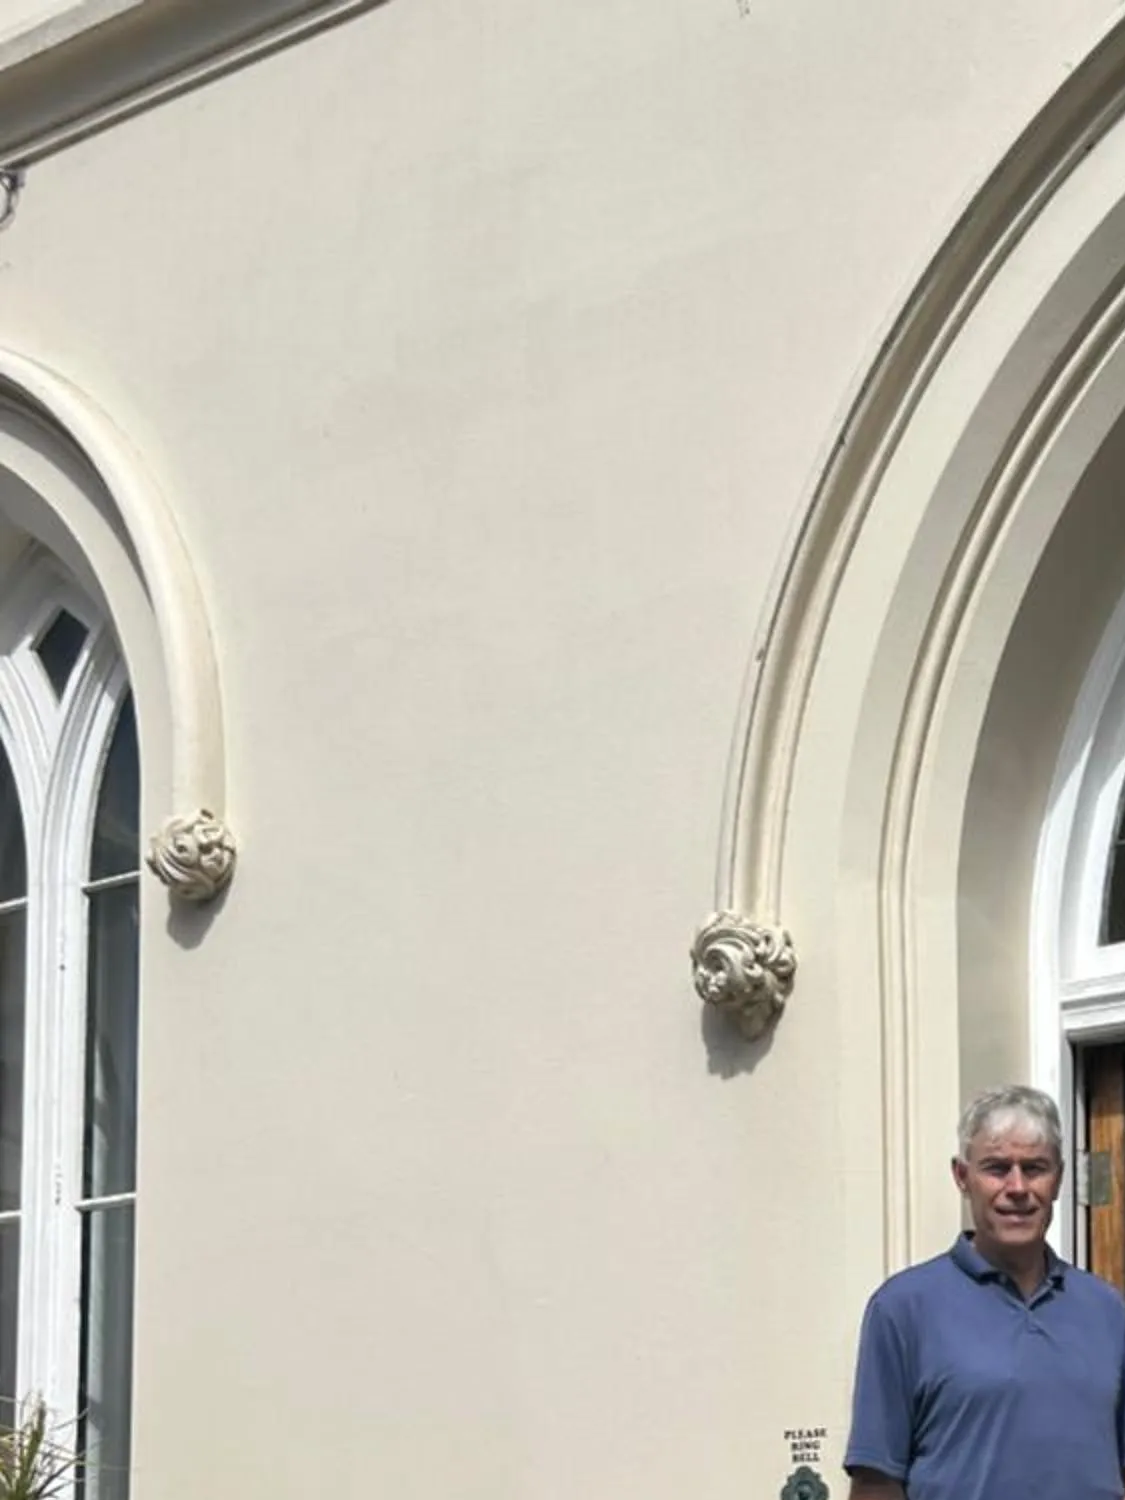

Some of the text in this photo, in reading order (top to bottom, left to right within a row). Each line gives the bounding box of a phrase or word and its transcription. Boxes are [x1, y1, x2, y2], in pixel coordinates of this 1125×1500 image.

[784, 1428, 827, 1440] PLEASE
[791, 1441, 820, 1451] RING
[792, 1453, 820, 1462] BELL
